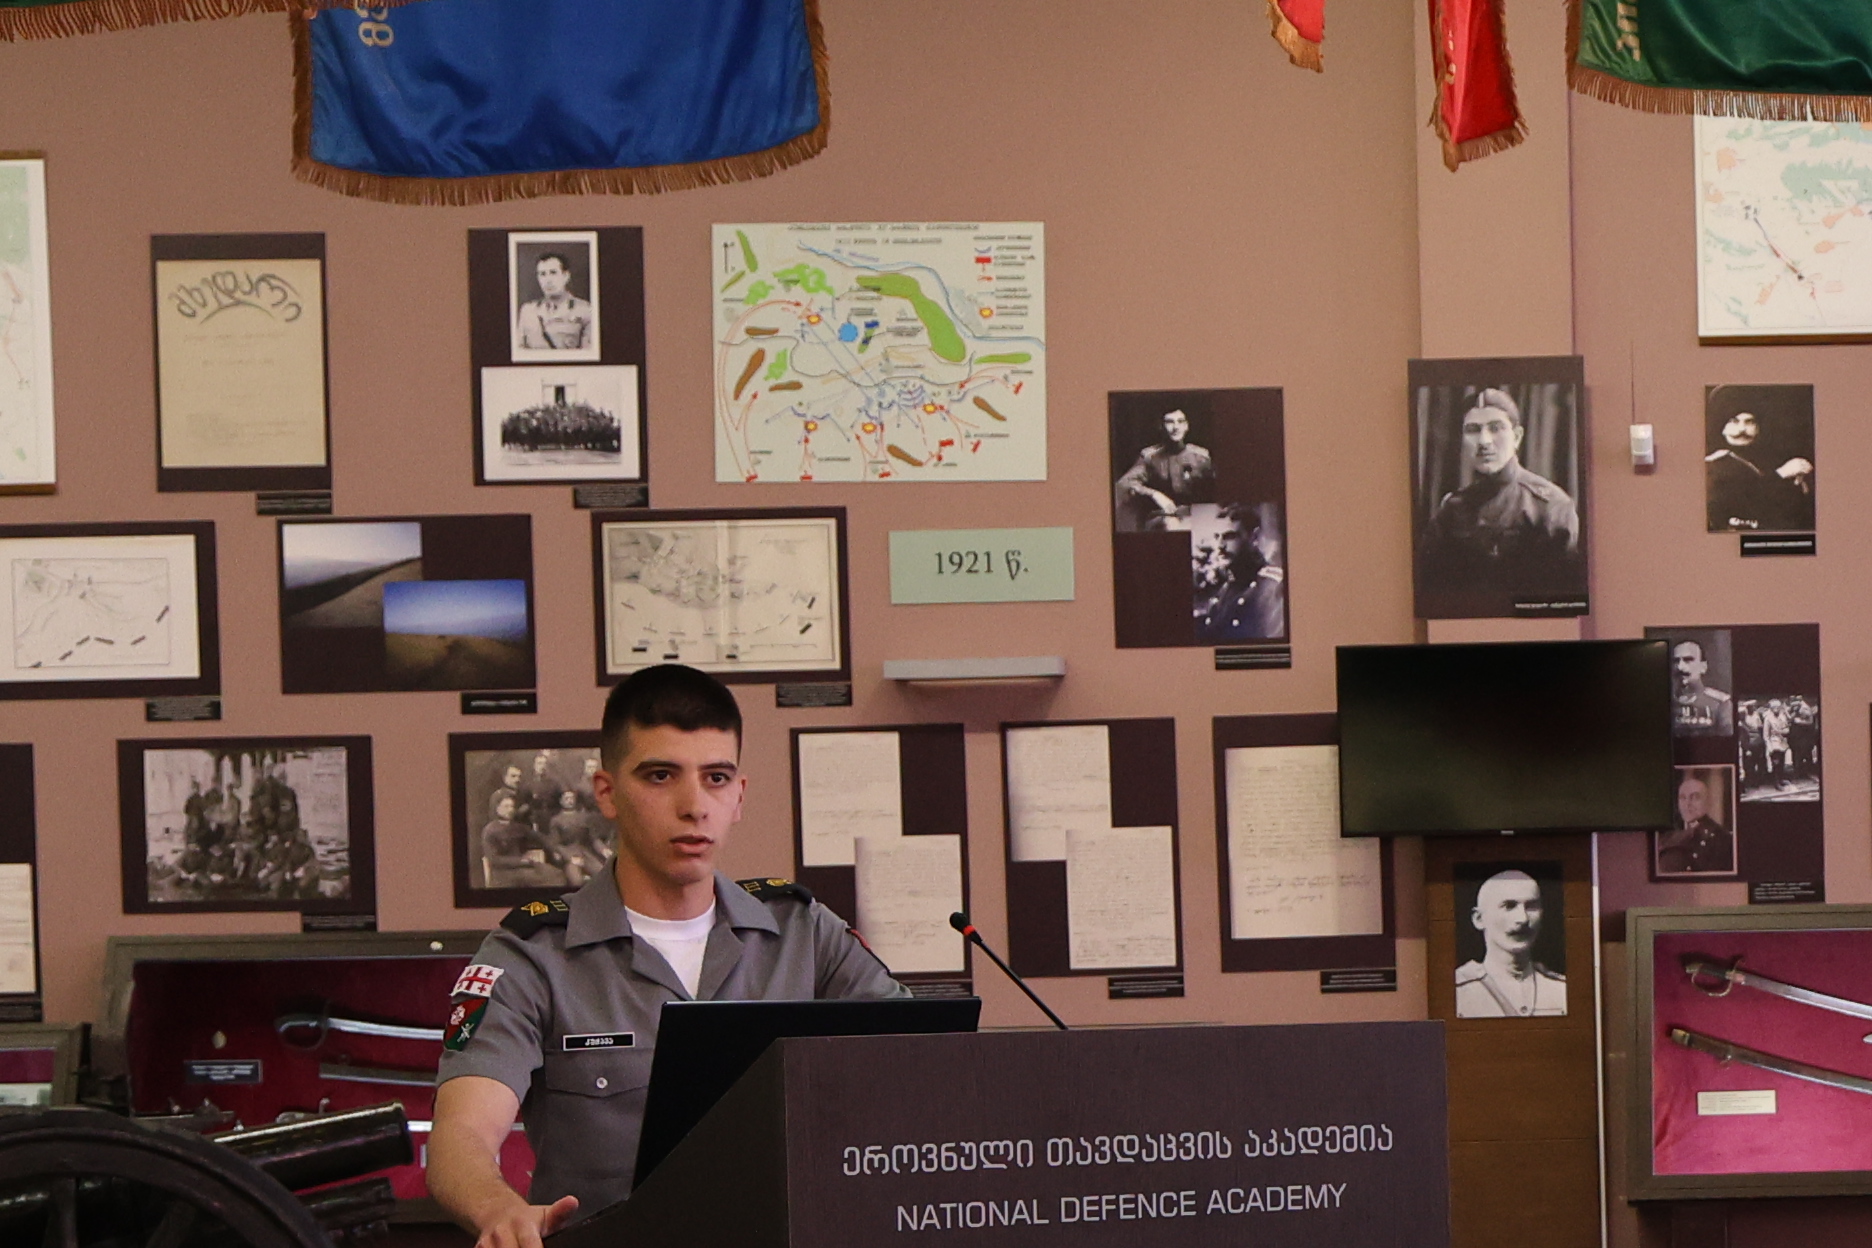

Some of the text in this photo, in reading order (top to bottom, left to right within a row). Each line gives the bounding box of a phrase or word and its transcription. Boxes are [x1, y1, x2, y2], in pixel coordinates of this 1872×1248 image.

[935, 550, 1028, 580] 1921 წ.
[844, 1124, 1392, 1175] ეროვნული თავდაცვის აკადემია
[898, 1183, 1346, 1231] NATIONAL DEFENCE ACADEMY
